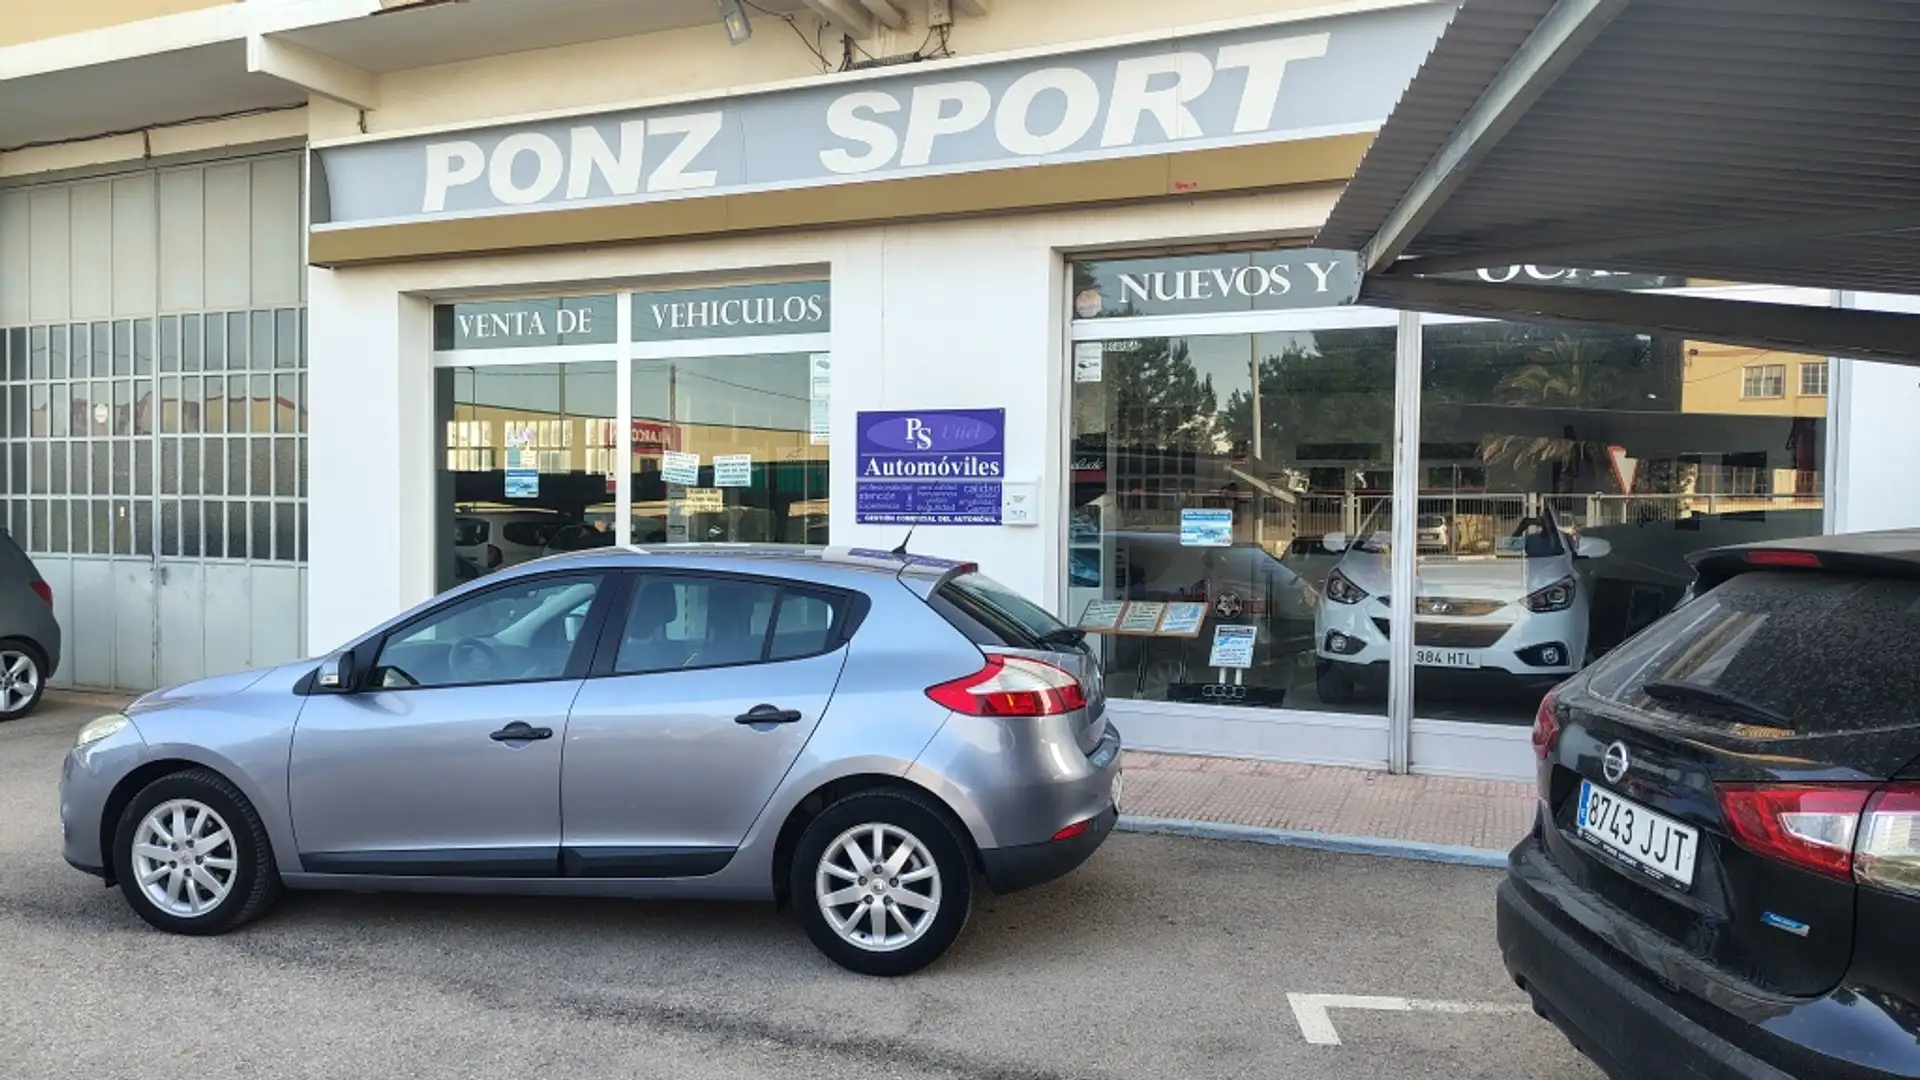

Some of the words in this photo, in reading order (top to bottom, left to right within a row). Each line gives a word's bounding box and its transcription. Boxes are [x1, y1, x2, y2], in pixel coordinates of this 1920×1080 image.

[422, 111, 723, 213] PONZ
[819, 32, 1331, 173] SPORT
[1118, 264, 1292, 303] NUEVOS
[1304, 260, 1340, 292] Y
[459, 310, 547, 338] VENTA
[556, 308, 593, 334] DE
[652, 294, 823, 330] VEHICULOS
[905, 418, 932, 450] PS
[942, 422, 981, 440] Utiel
[864, 456, 1000, 476] Automóviles
[1416, 650, 1441, 663] 984
[1447, 652, 1475, 665] HTL
[1588, 792, 1634, 845] 8743
[1640, 819, 1689, 871] JJT
